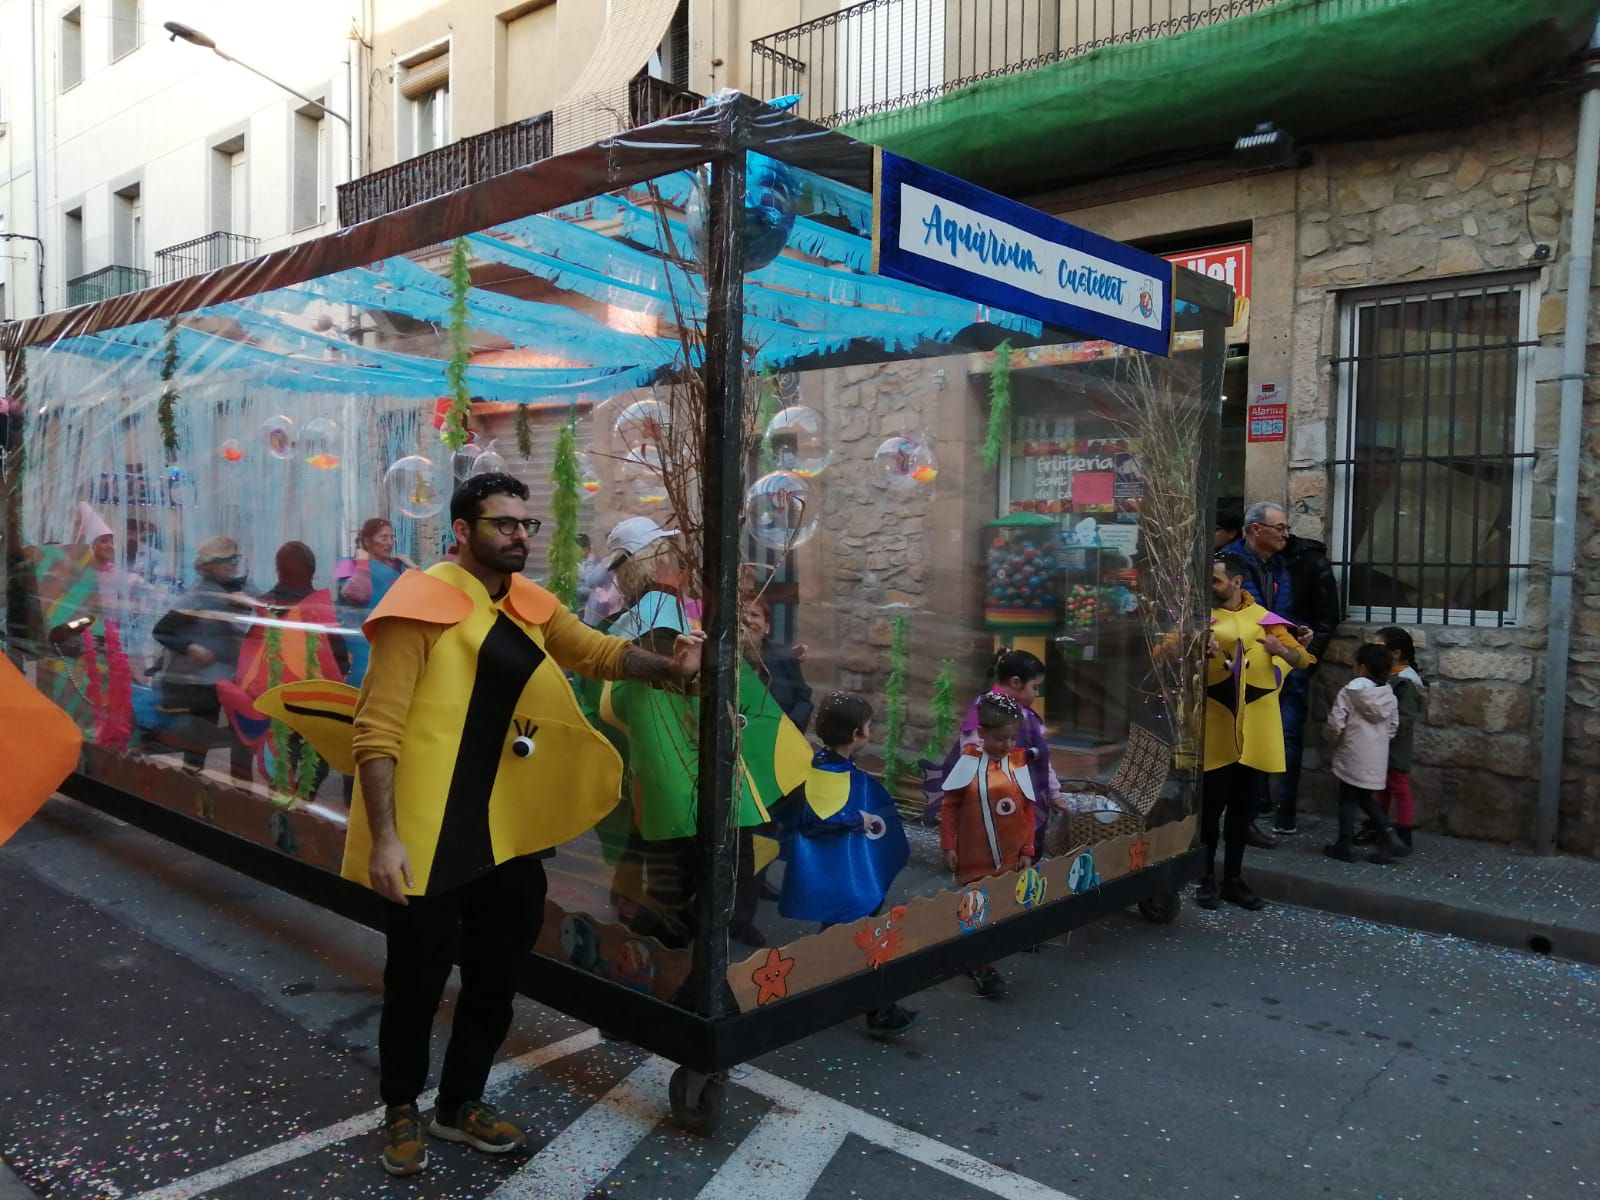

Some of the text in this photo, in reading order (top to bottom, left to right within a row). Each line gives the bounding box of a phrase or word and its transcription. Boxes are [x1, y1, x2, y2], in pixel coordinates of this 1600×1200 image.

[923, 204, 1127, 305] Aquàrium Castellet
[1252, 407, 1284, 416] Alarma
[1037, 455, 1113, 472] fruiteria
